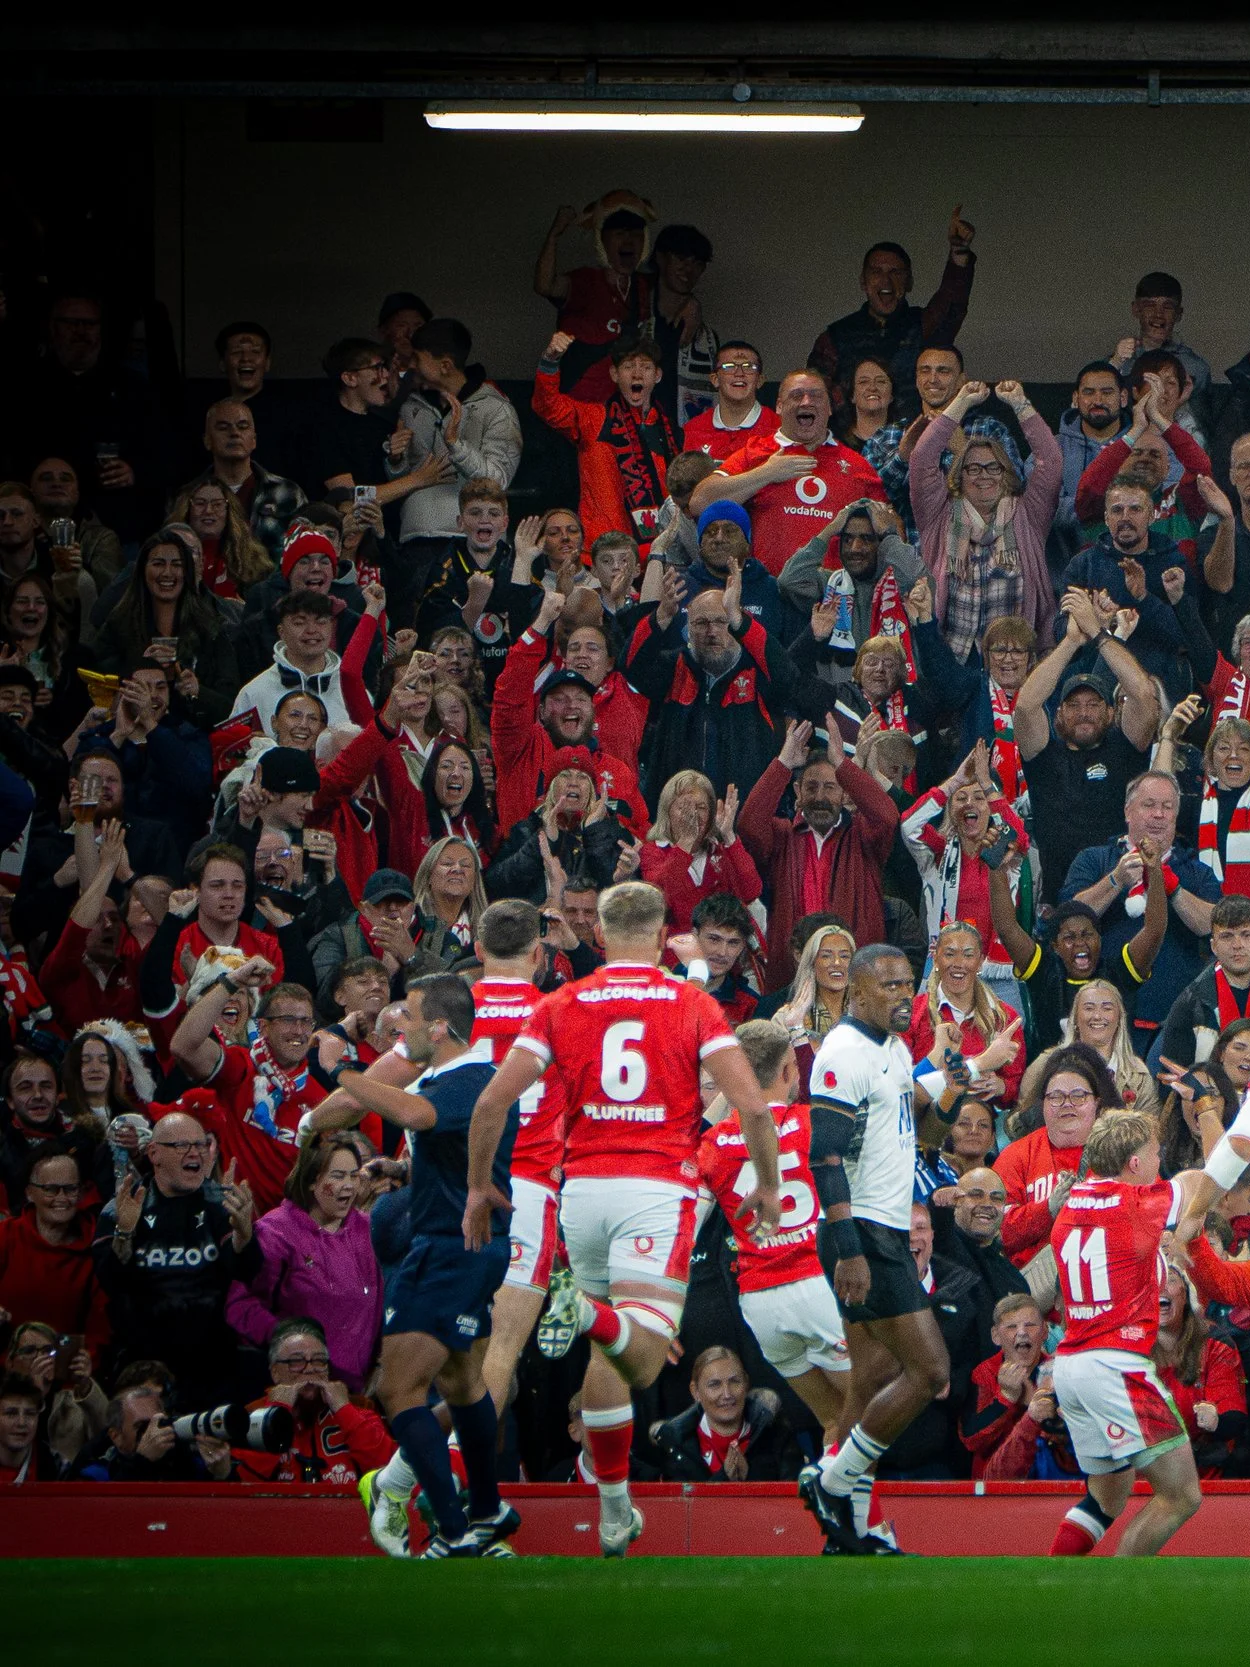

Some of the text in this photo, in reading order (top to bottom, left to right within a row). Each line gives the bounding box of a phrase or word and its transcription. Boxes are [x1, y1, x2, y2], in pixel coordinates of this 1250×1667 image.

[783, 505, 833, 519] vodafone
[481, 647, 508, 657] afon
[601, 1020, 647, 1102] 6
[583, 1104, 665, 1121] PLUMTREE
[1060, 1227, 1112, 1302] 11
[1069, 1304, 1113, 1319] MURRAY
